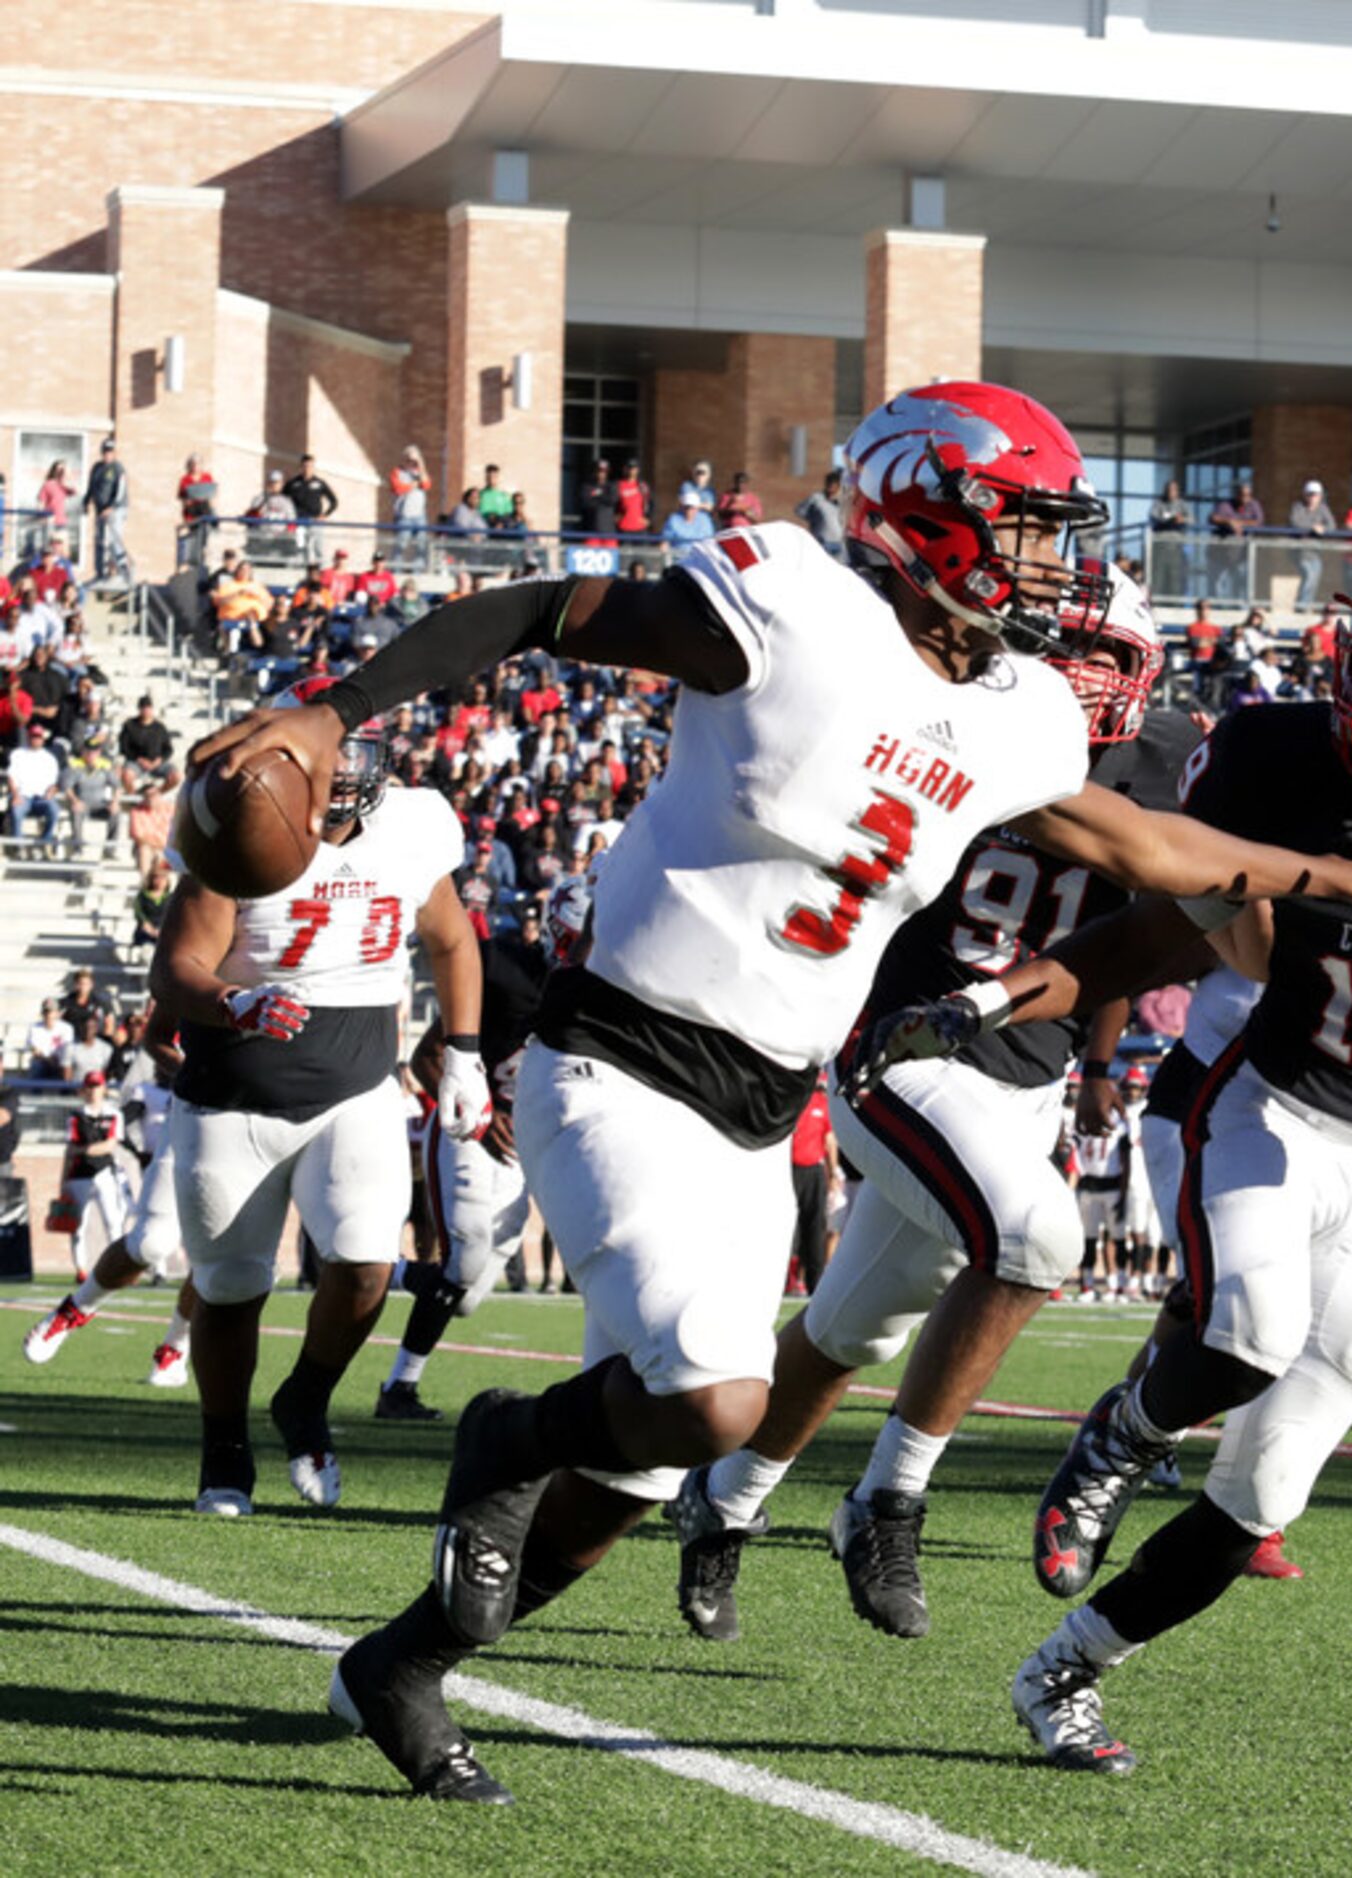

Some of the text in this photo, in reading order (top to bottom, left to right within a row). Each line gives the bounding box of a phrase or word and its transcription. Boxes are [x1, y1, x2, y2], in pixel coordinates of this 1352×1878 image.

[572, 550, 612, 574] 120
[863, 733, 975, 814] HORN
[765, 787, 919, 959] 3
[951, 840, 1091, 975] 91
[277, 895, 402, 971] 70
